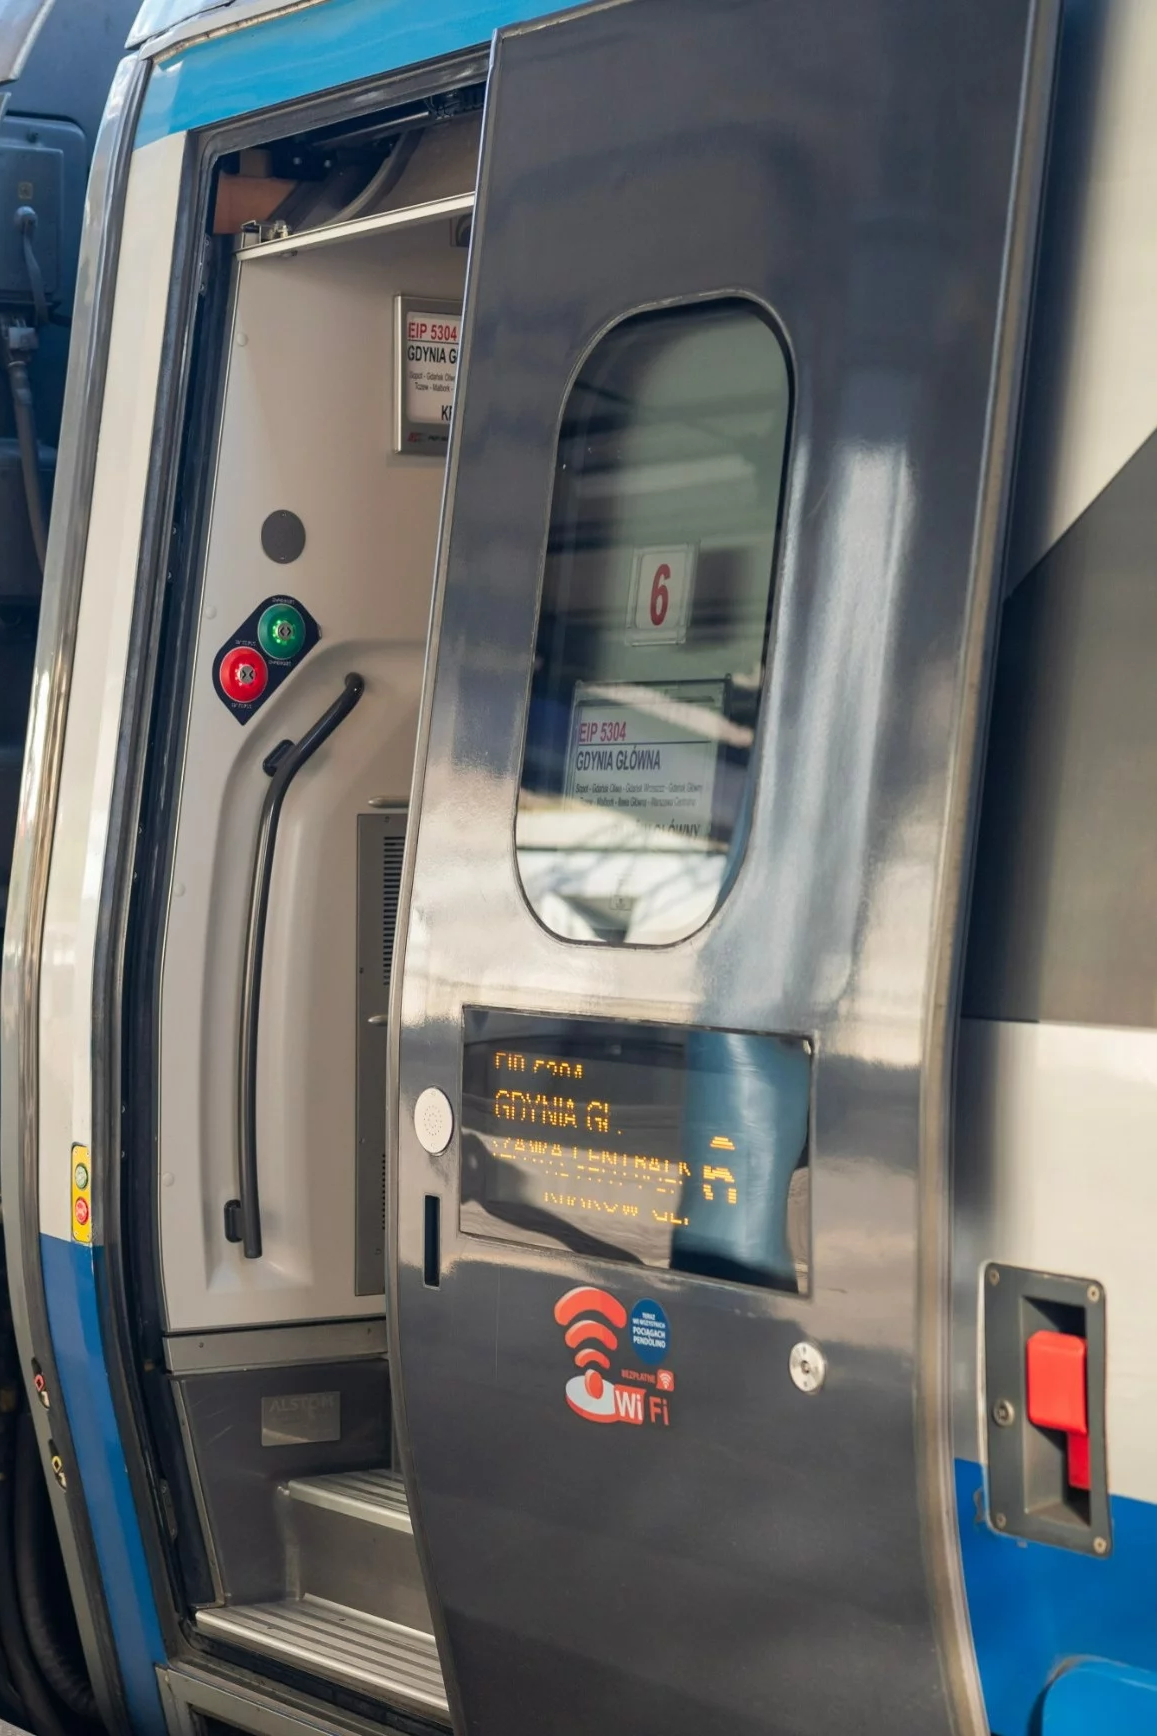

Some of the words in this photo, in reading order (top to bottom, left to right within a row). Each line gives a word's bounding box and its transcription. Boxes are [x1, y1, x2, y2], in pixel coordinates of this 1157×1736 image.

[408, 322, 427, 338] EIP
[430, 324, 457, 342] 5304
[407, 345, 446, 363] GDYNIA
[448, 347, 458, 365] G
[441, 404, 452, 421] K
[650, 563, 671, 626] 6
[579, 722, 598, 743] EIP
[600, 721, 627, 742] 5304
[576, 750, 614, 771] GDYNIA
[616, 746, 661, 770] GŁÓWNA
[633, 1336, 666, 1349] PENDOLINO
[269, 1395, 335, 1413] ALSTOM
